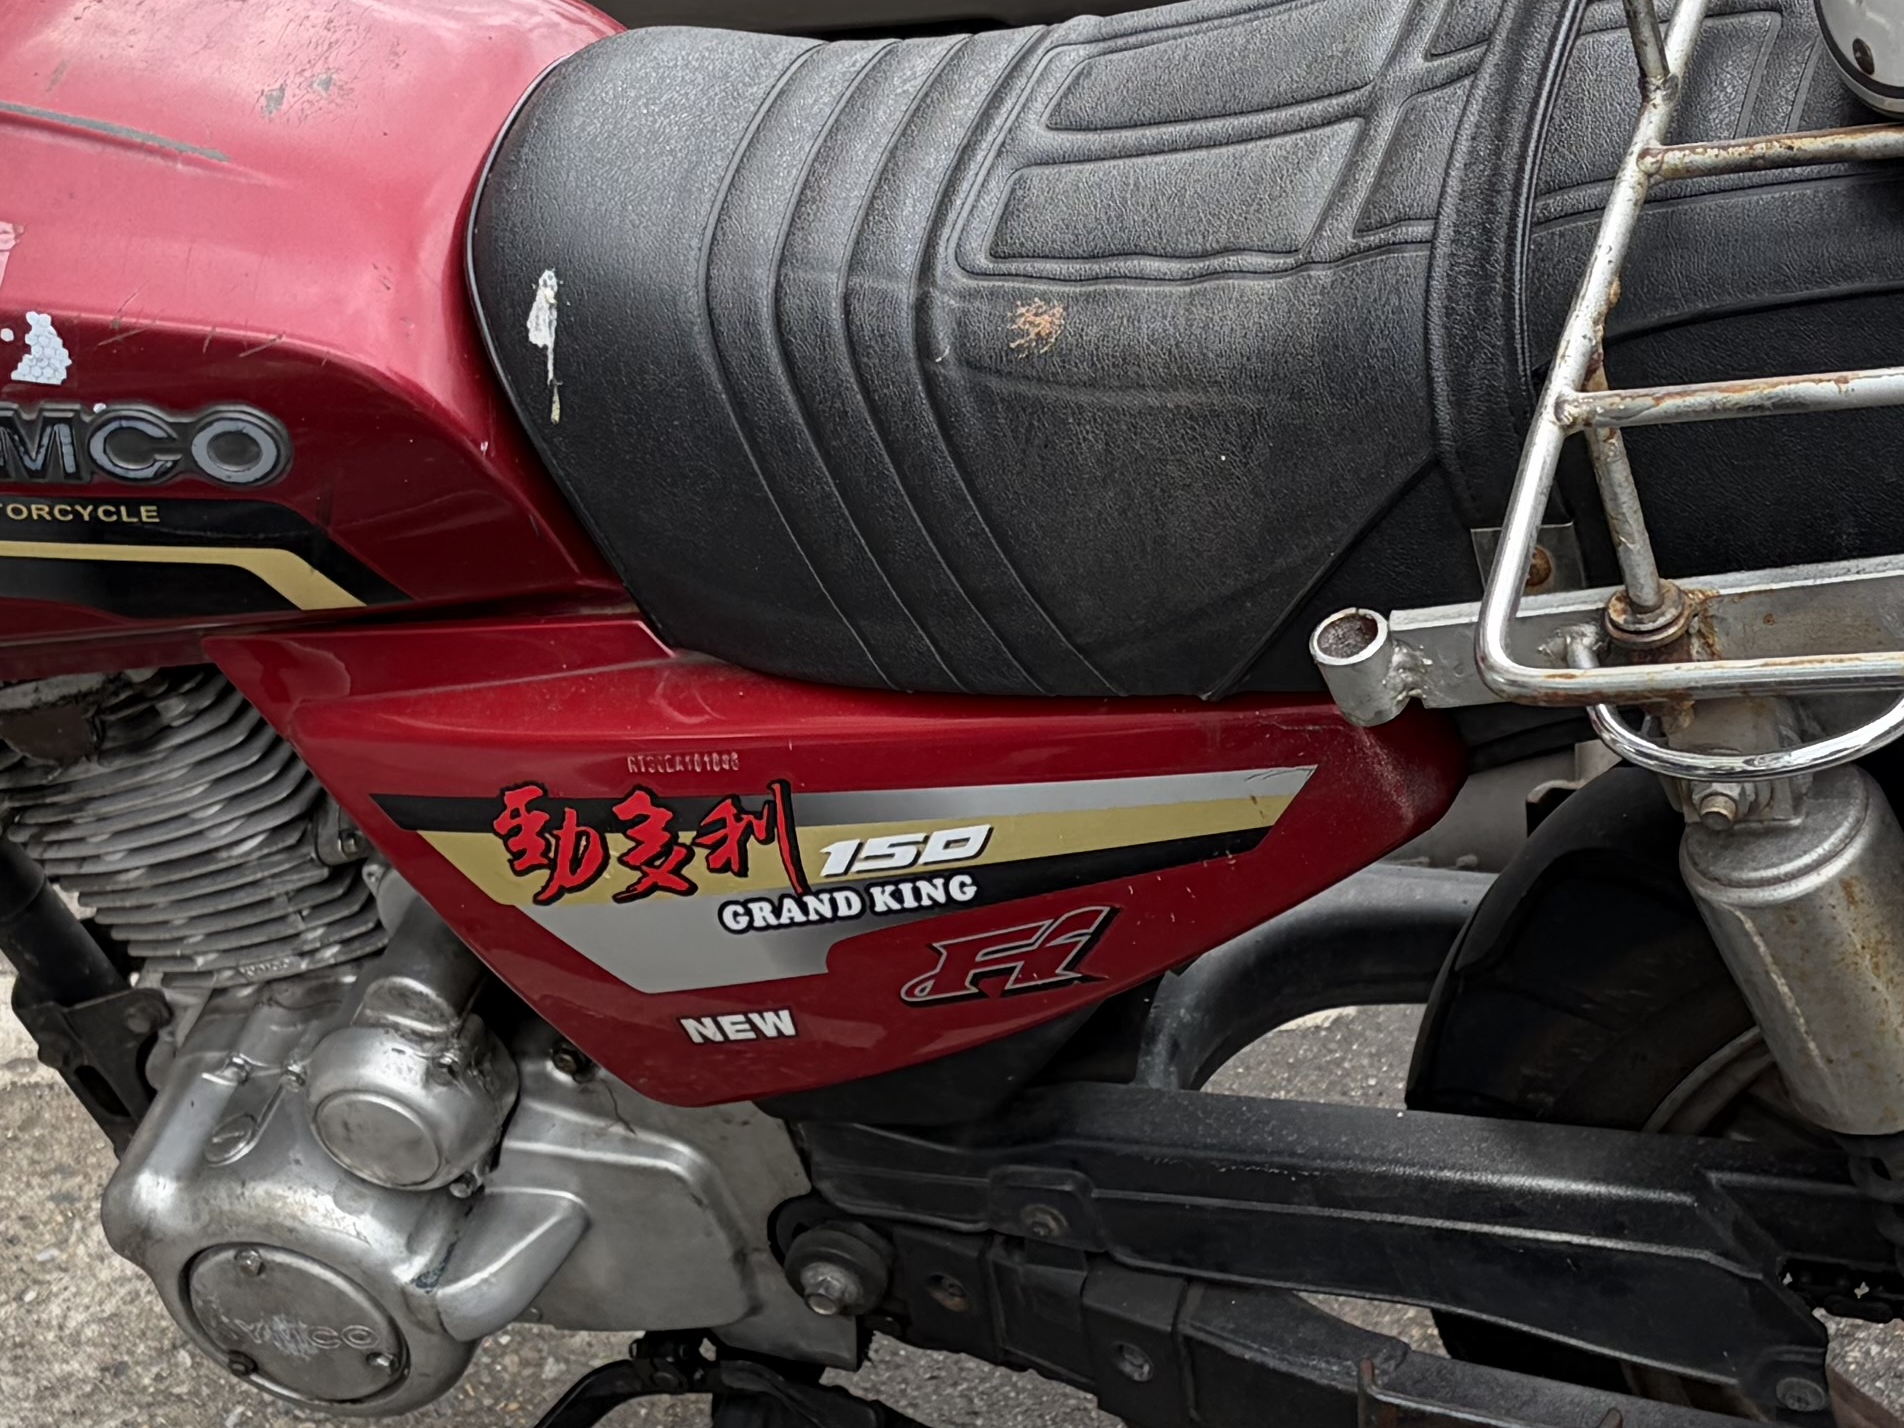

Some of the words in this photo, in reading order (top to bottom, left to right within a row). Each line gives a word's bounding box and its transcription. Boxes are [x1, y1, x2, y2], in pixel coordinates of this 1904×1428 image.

[820, 824, 993, 877] 150
[722, 888, 863, 933] GRAND
[869, 874, 979, 914] KING
[677, 1008, 797, 1047] NEW
